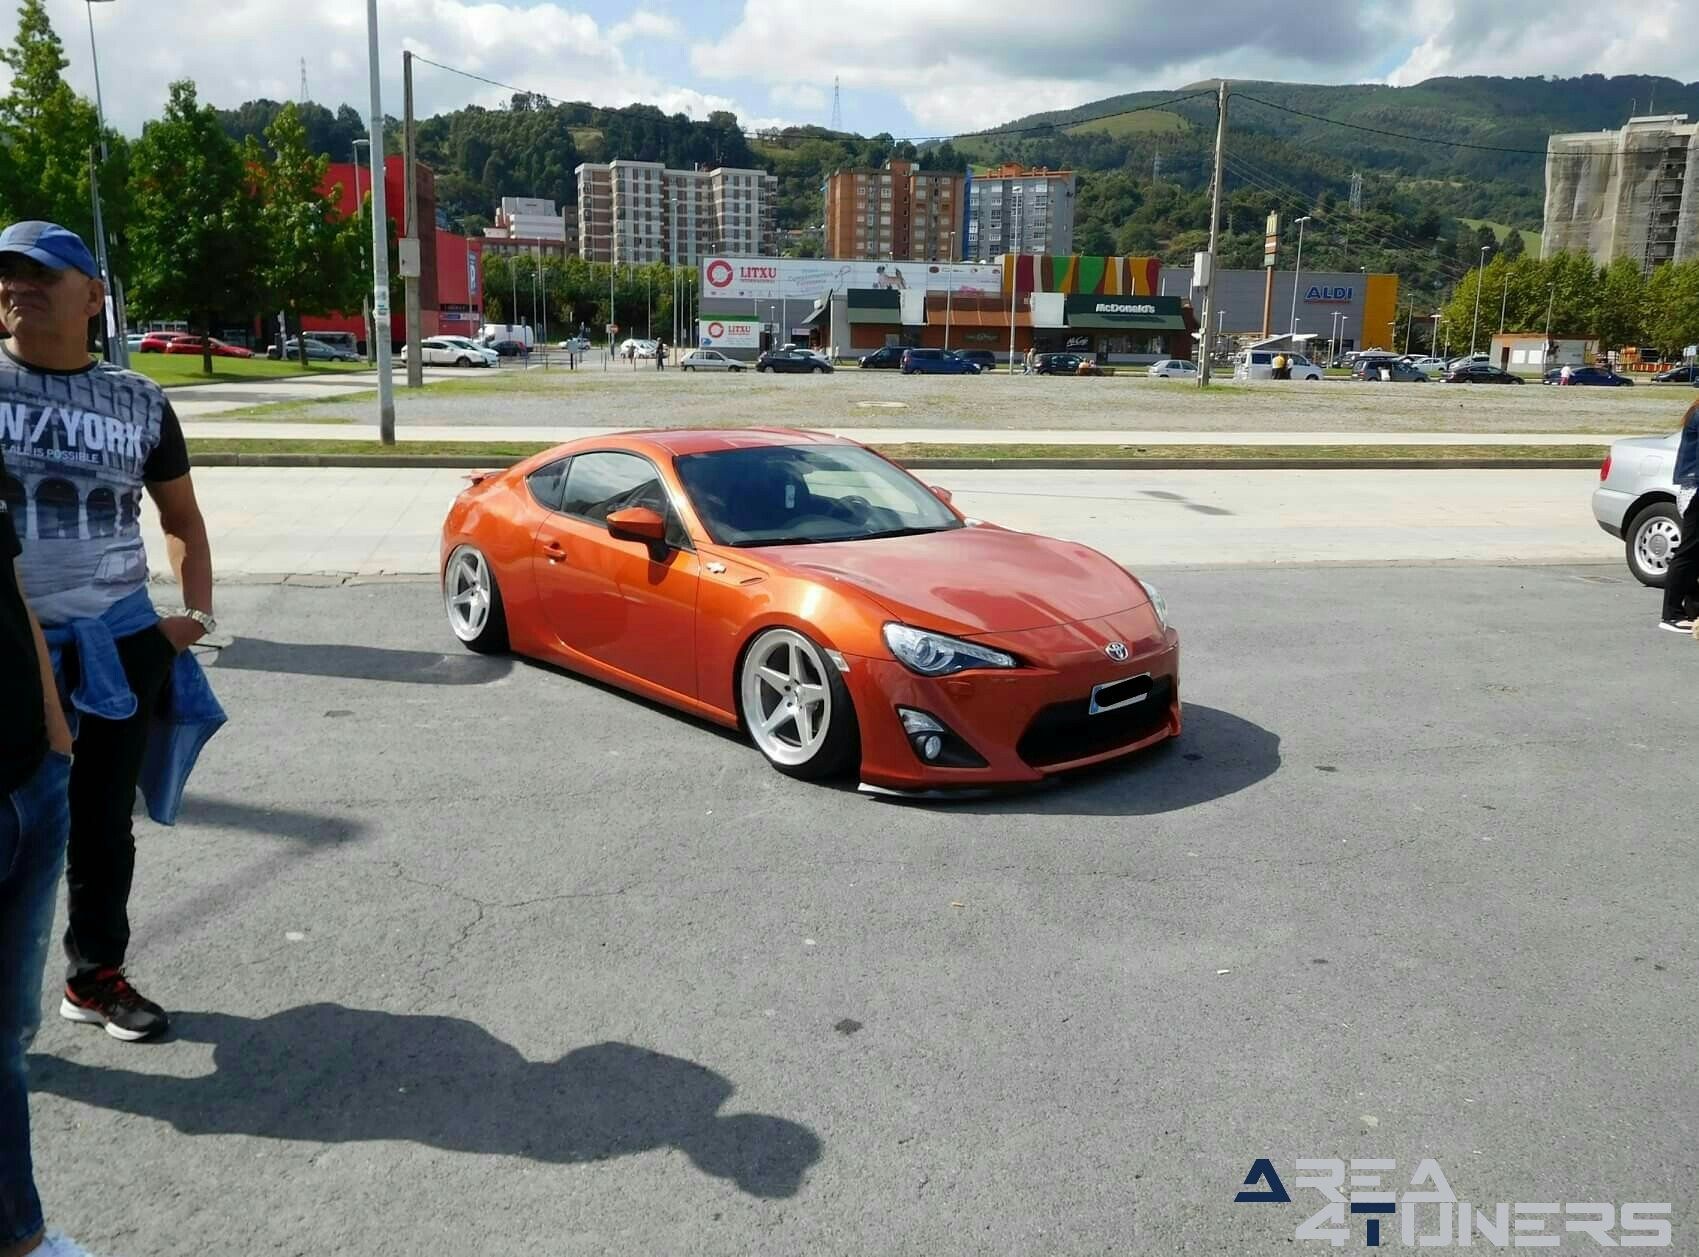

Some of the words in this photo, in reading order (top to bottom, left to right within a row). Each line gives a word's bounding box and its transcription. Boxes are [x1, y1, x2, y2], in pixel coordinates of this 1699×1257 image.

[740, 266, 777, 279] LITXU
[1306, 286, 1353, 299] ALDI
[1095, 303, 1155, 313] McDonald's
[728, 325, 751, 333] LITXU
[46, 448, 101, 464] POSSIBLE
